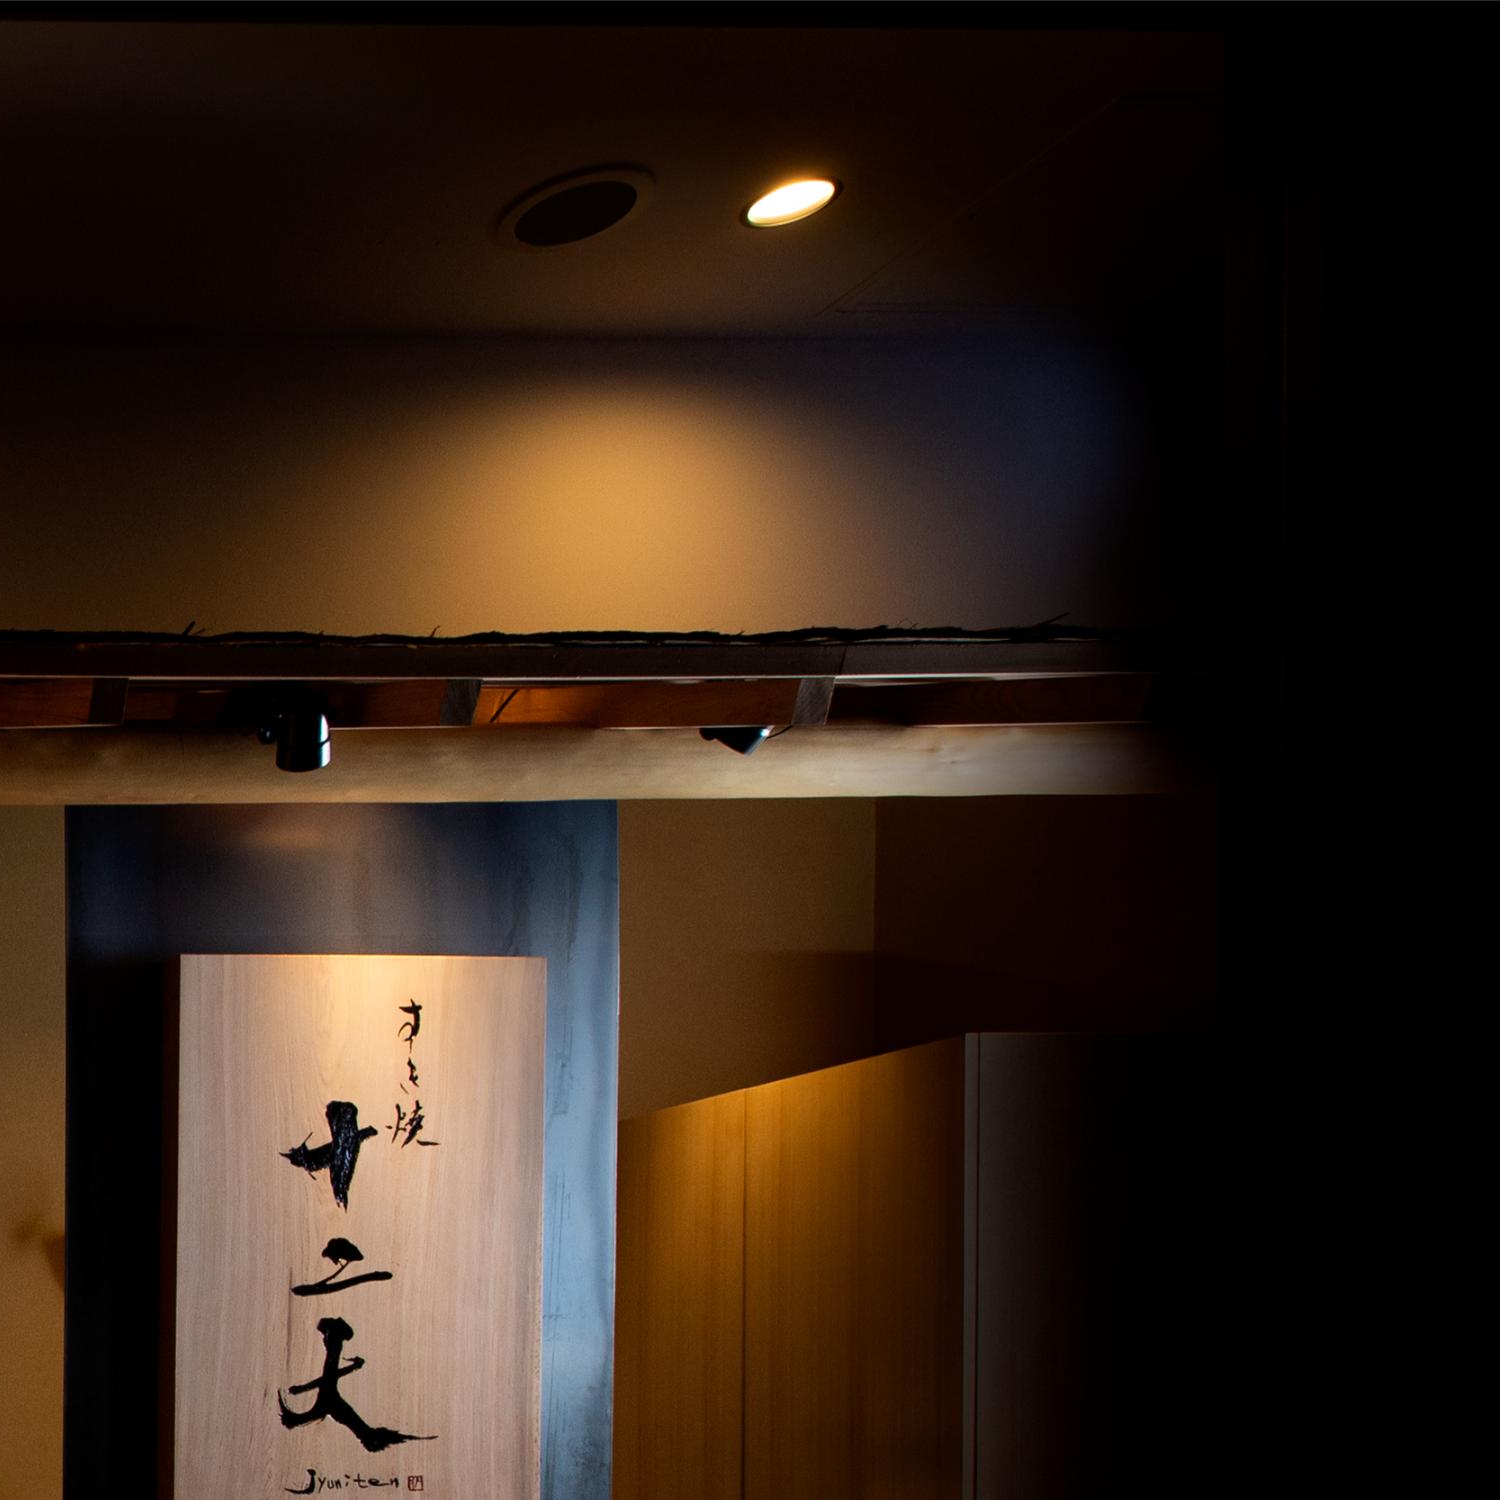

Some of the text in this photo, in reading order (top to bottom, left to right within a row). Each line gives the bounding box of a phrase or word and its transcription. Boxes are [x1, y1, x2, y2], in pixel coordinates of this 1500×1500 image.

[277, 1099, 440, 1453] 十二天
[284, 1468, 400, 1496] Jyuniten
